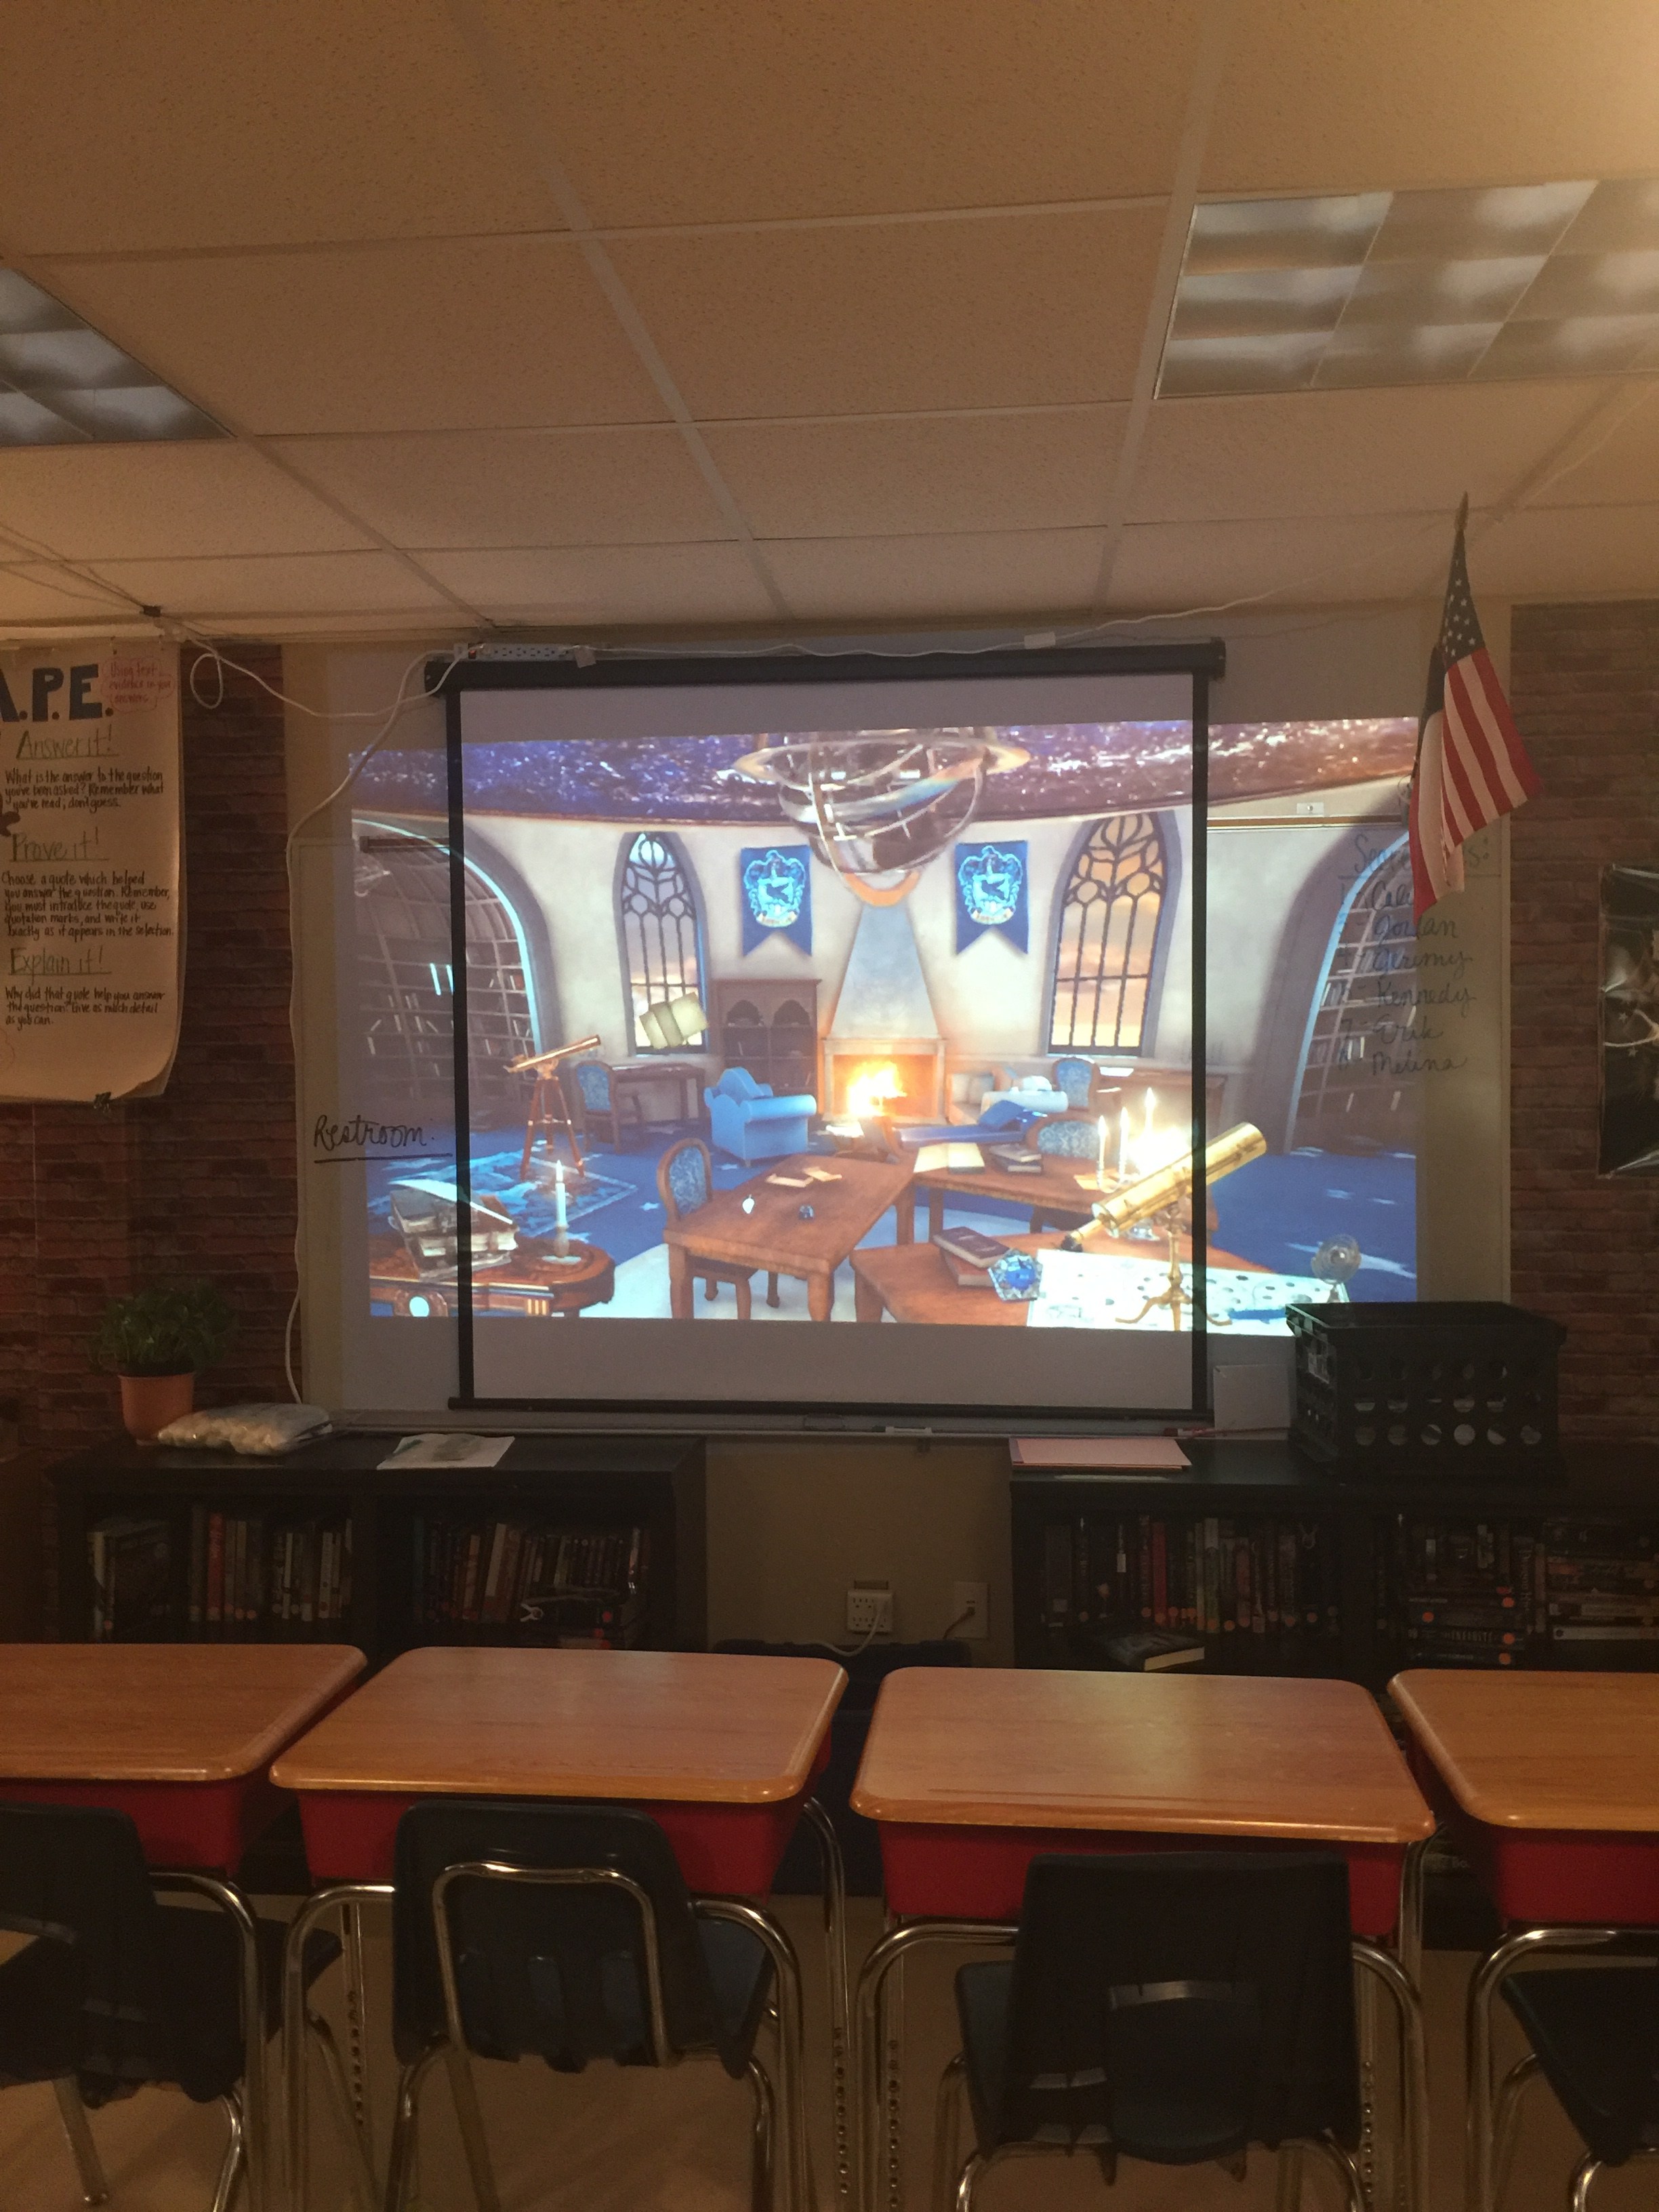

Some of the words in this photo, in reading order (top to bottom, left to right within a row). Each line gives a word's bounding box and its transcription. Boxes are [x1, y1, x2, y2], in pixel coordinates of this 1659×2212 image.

[16, 730, 82, 758] Answer
[5, 767, 32, 784] What
[36, 772, 45, 783] is
[46, 769, 60, 783] the
[62, 771, 93, 782] answer
[98, 766, 107, 781] to
[108, 767, 125, 781] the
[126, 766, 163, 786] question
[33, 785, 52, 796] been
[53, 782, 86, 796] asked?
[89, 784, 139, 796] Remember
[12, 832, 68, 862] Prove
[2, 870, 35, 885] Choose
[41, 874, 47, 884] a
[49, 870, 77, 891] quote
[79, 872, 107, 886] which
[112, 869, 145, 884] helped
[5, 888, 20, 902] you
[22, 888, 54, 900] answer
[59, 886, 72, 898] the
[25, 900, 46, 912] must
[50, 897, 92, 912] introduce
[96, 901, 112, 912] the
[4, 913, 47, 929] quotation
[85, 913, 101, 924] and
[104, 913, 129, 924] write
[131, 914, 140, 923] it
[59, 925, 66, 935] it
[68, 926, 103, 942] appears
[106, 926, 116, 936] in
[119, 925, 133, 936] the
[11, 947, 70, 986] Explain
[1374, 947, 1473, 979] Jeremy
[5, 986, 22, 1003] Why
[25, 986, 41, 1000] did
[45, 986, 63, 1000] that
[66, 987, 90, 1004] quote
[94, 987, 112, 1002] help
[114, 991, 131, 1004] you
[133, 991, 165, 1000] answer
[1378, 980, 1477, 1017] Kennedy
[7, 1002, 22, 1012] the
[92, 1004, 102, 1012] as
[104, 1002, 128, 1013] much
[129, 1000, 158, 1013] detail
[5, 1016, 15, 1025] as
[18, 1015, 33, 1031] you
[1372, 1050, 1468, 1076] Melina
